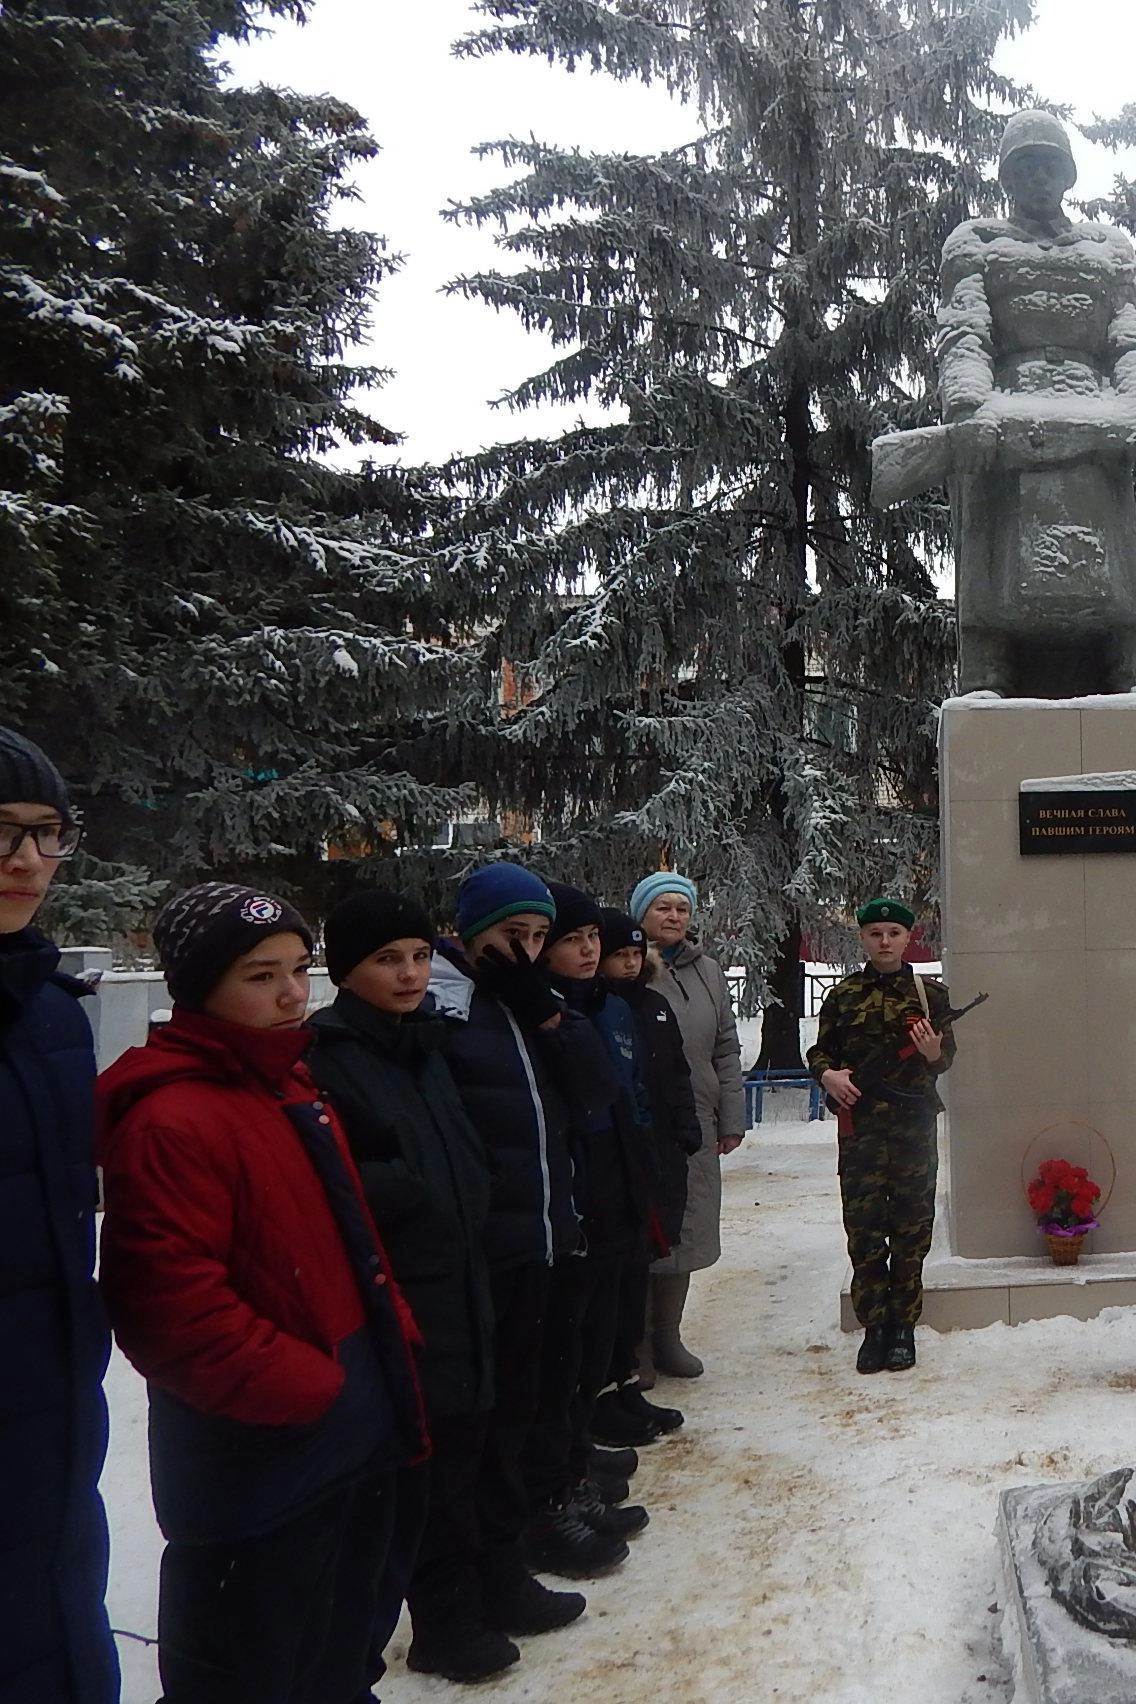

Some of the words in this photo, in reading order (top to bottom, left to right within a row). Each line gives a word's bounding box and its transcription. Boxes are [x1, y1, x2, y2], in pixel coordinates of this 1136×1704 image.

[1039, 808, 1084, 819] ВЕЧНАЯ
[1088, 808, 1126, 818] СЛАВА
[1031, 826, 1085, 836] ПАВШИМ
[1088, 825, 1135, 835] ГЕРОЯМ
